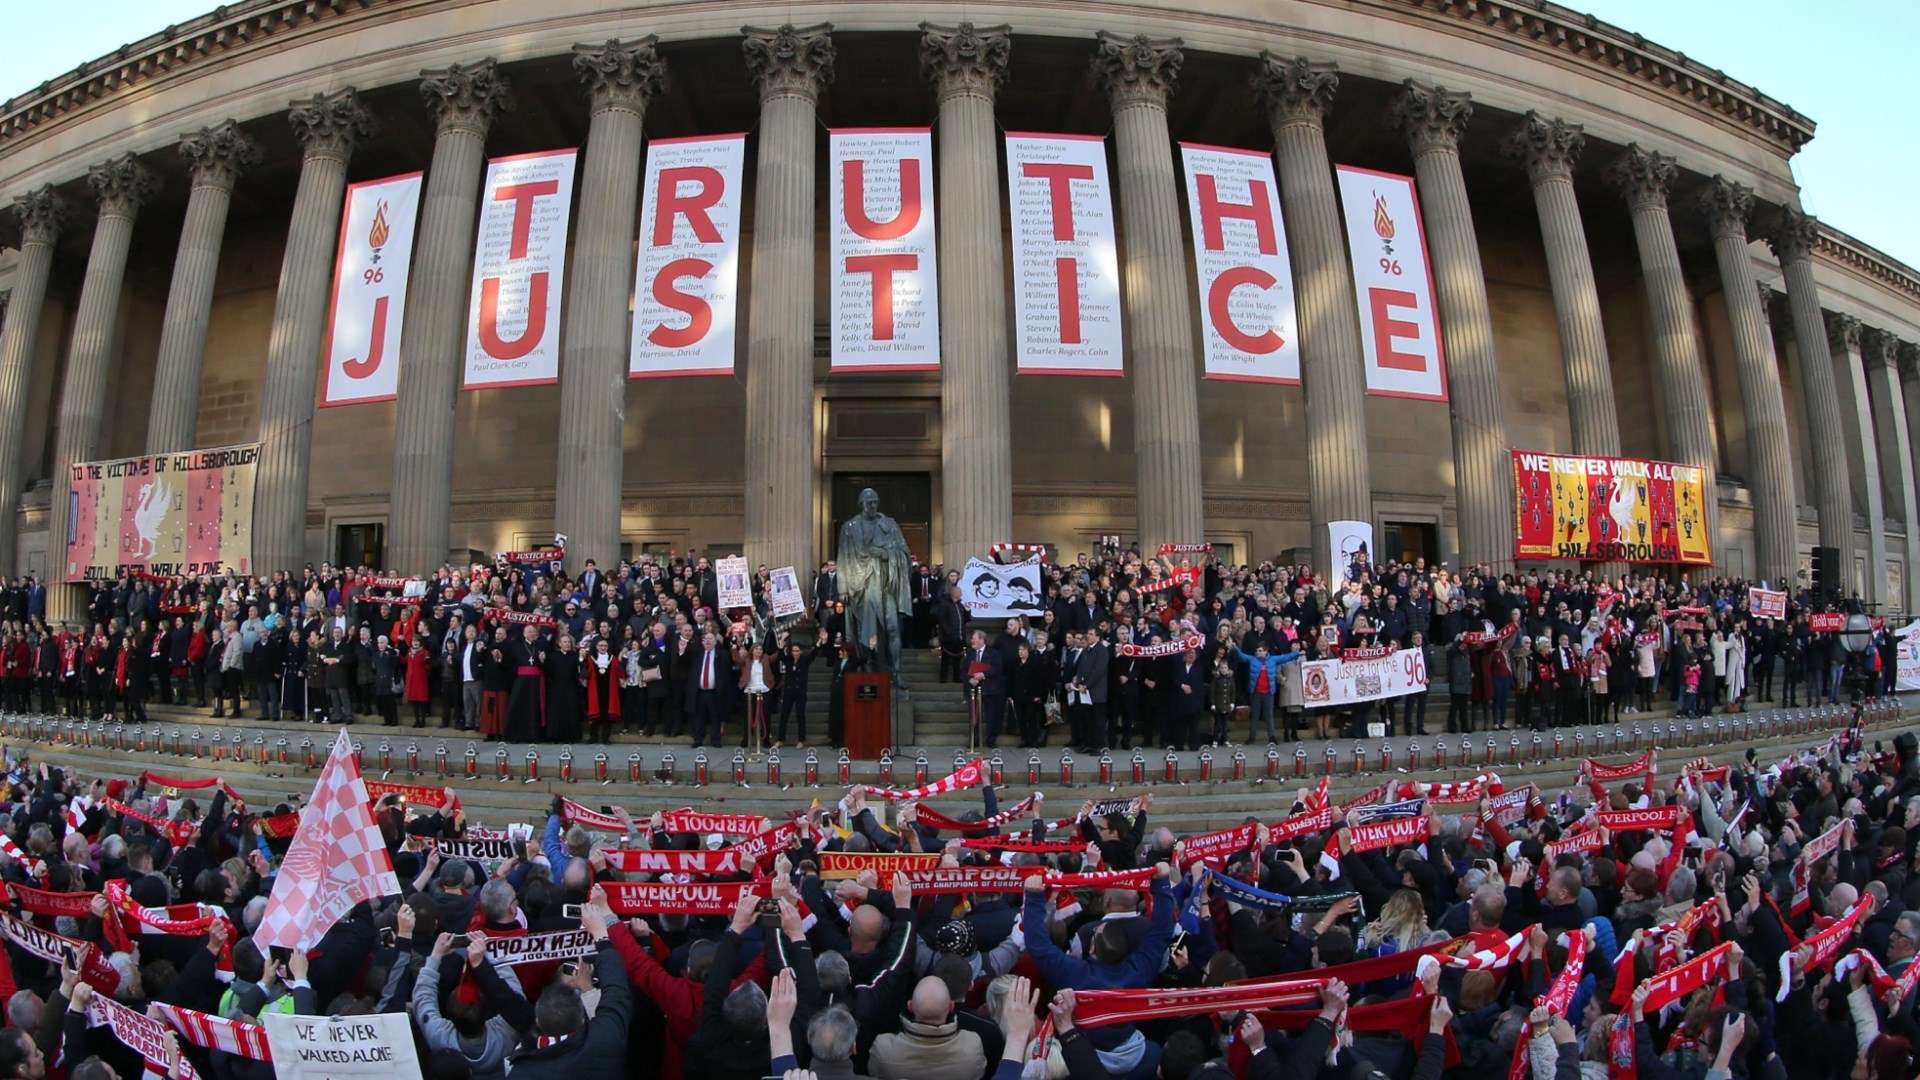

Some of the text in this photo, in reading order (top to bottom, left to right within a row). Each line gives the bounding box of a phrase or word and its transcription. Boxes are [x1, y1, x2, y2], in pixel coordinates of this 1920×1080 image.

[653, 166, 725, 246] R
[843, 159, 921, 240] U
[1022, 163, 1094, 241] T
[495, 180, 559, 260] T
[1196, 174, 1278, 256] H
[364, 267, 384, 285] 96
[1379, 258, 1402, 276] 96
[648, 258, 714, 348] S
[846, 254, 918, 341] T
[1025, 291, 1057, 300] William
[1056, 257, 1081, 344] I
[1025, 302, 1048, 311] David
[1208, 266, 1285, 354] C
[479, 272, 549, 360] U
[897, 321, 920, 330] David
[1368, 287, 1427, 373] E
[342, 296, 389, 379] J
[677, 348, 701, 357] David
[868, 343, 892, 353] David
[893, 343, 925, 352] William
[1026, 347, 1057, 356] Charles
[1089, 347, 1110, 356] Colin
[474, 362, 490, 372] Paul
[1211, 354, 1229, 364] John
[73, 447, 259, 480] TO THE VICTIMS OF HILLSBOROUGH
[1519, 453, 1698, 484] WE NEVER WALK ALONE
[516, 551, 545, 560] JUSTICE
[1174, 544, 1205, 552] JUSTICE
[1558, 542, 1677, 560] HILLSBOROUGH
[152, 563, 184, 576] WALK
[189, 561, 224, 575] ALONE
[503, 611, 538, 623] JUSTICE
[1138, 641, 1186, 656] JUSTICE
[1356, 646, 1386, 657] JUSTICE
[1383, 658, 1398, 674] the
[1404, 651, 1425, 687] 96
[680, 816, 759, 834] VERPOOL
[775, 827, 789, 840] FC
[1350, 819, 1416, 845] LIVERPOOL
[823, 854, 937, 872] LIVERPOOL
[620, 885, 723, 902] LIVERPOOL
[934, 881, 979, 889] CHAMPIONS
[623, 900, 653, 909] YOU'LL
[660, 901, 688, 909] NEVER
[696, 901, 720, 909] WALK
[296, 1024, 379, 1043] WE NEVER
[298, 1047, 392, 1063] WALKED ALONE
